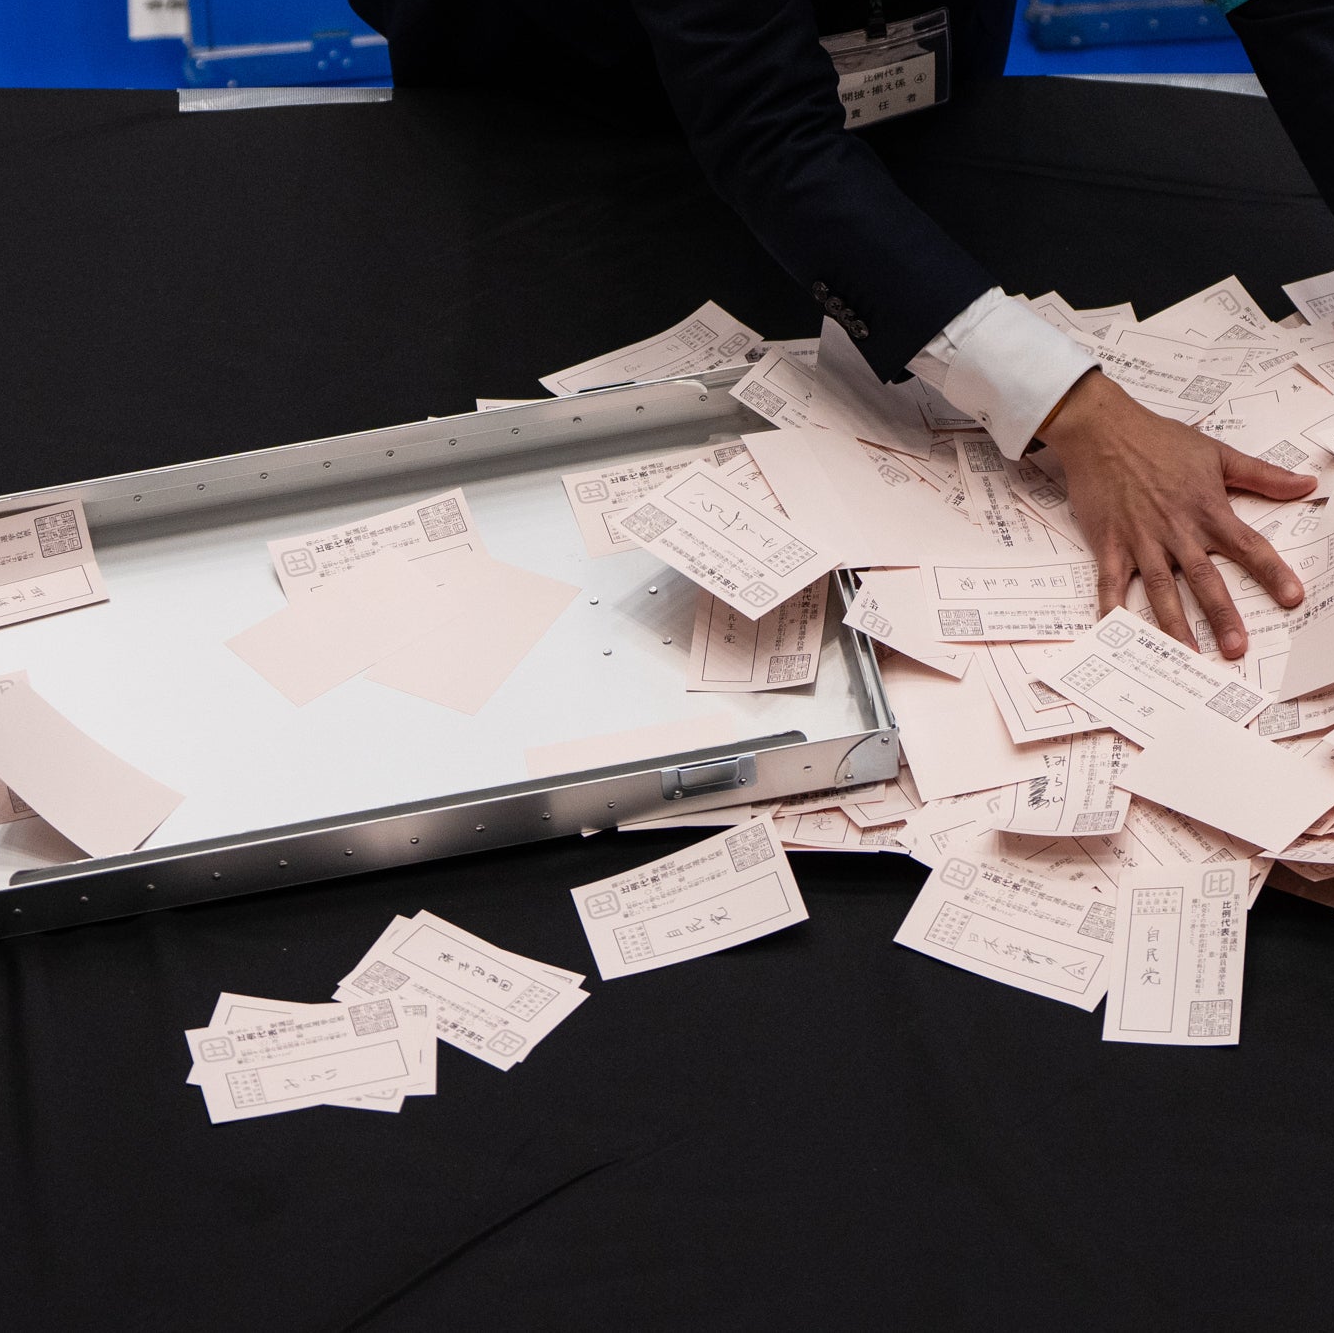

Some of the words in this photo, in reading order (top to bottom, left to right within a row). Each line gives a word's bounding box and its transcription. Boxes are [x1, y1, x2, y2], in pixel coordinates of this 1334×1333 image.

[862, 66, 905, 86] 比例代表
[663, 906, 732, 940] 自民党
[1141, 926, 1162, 987] 自民党
